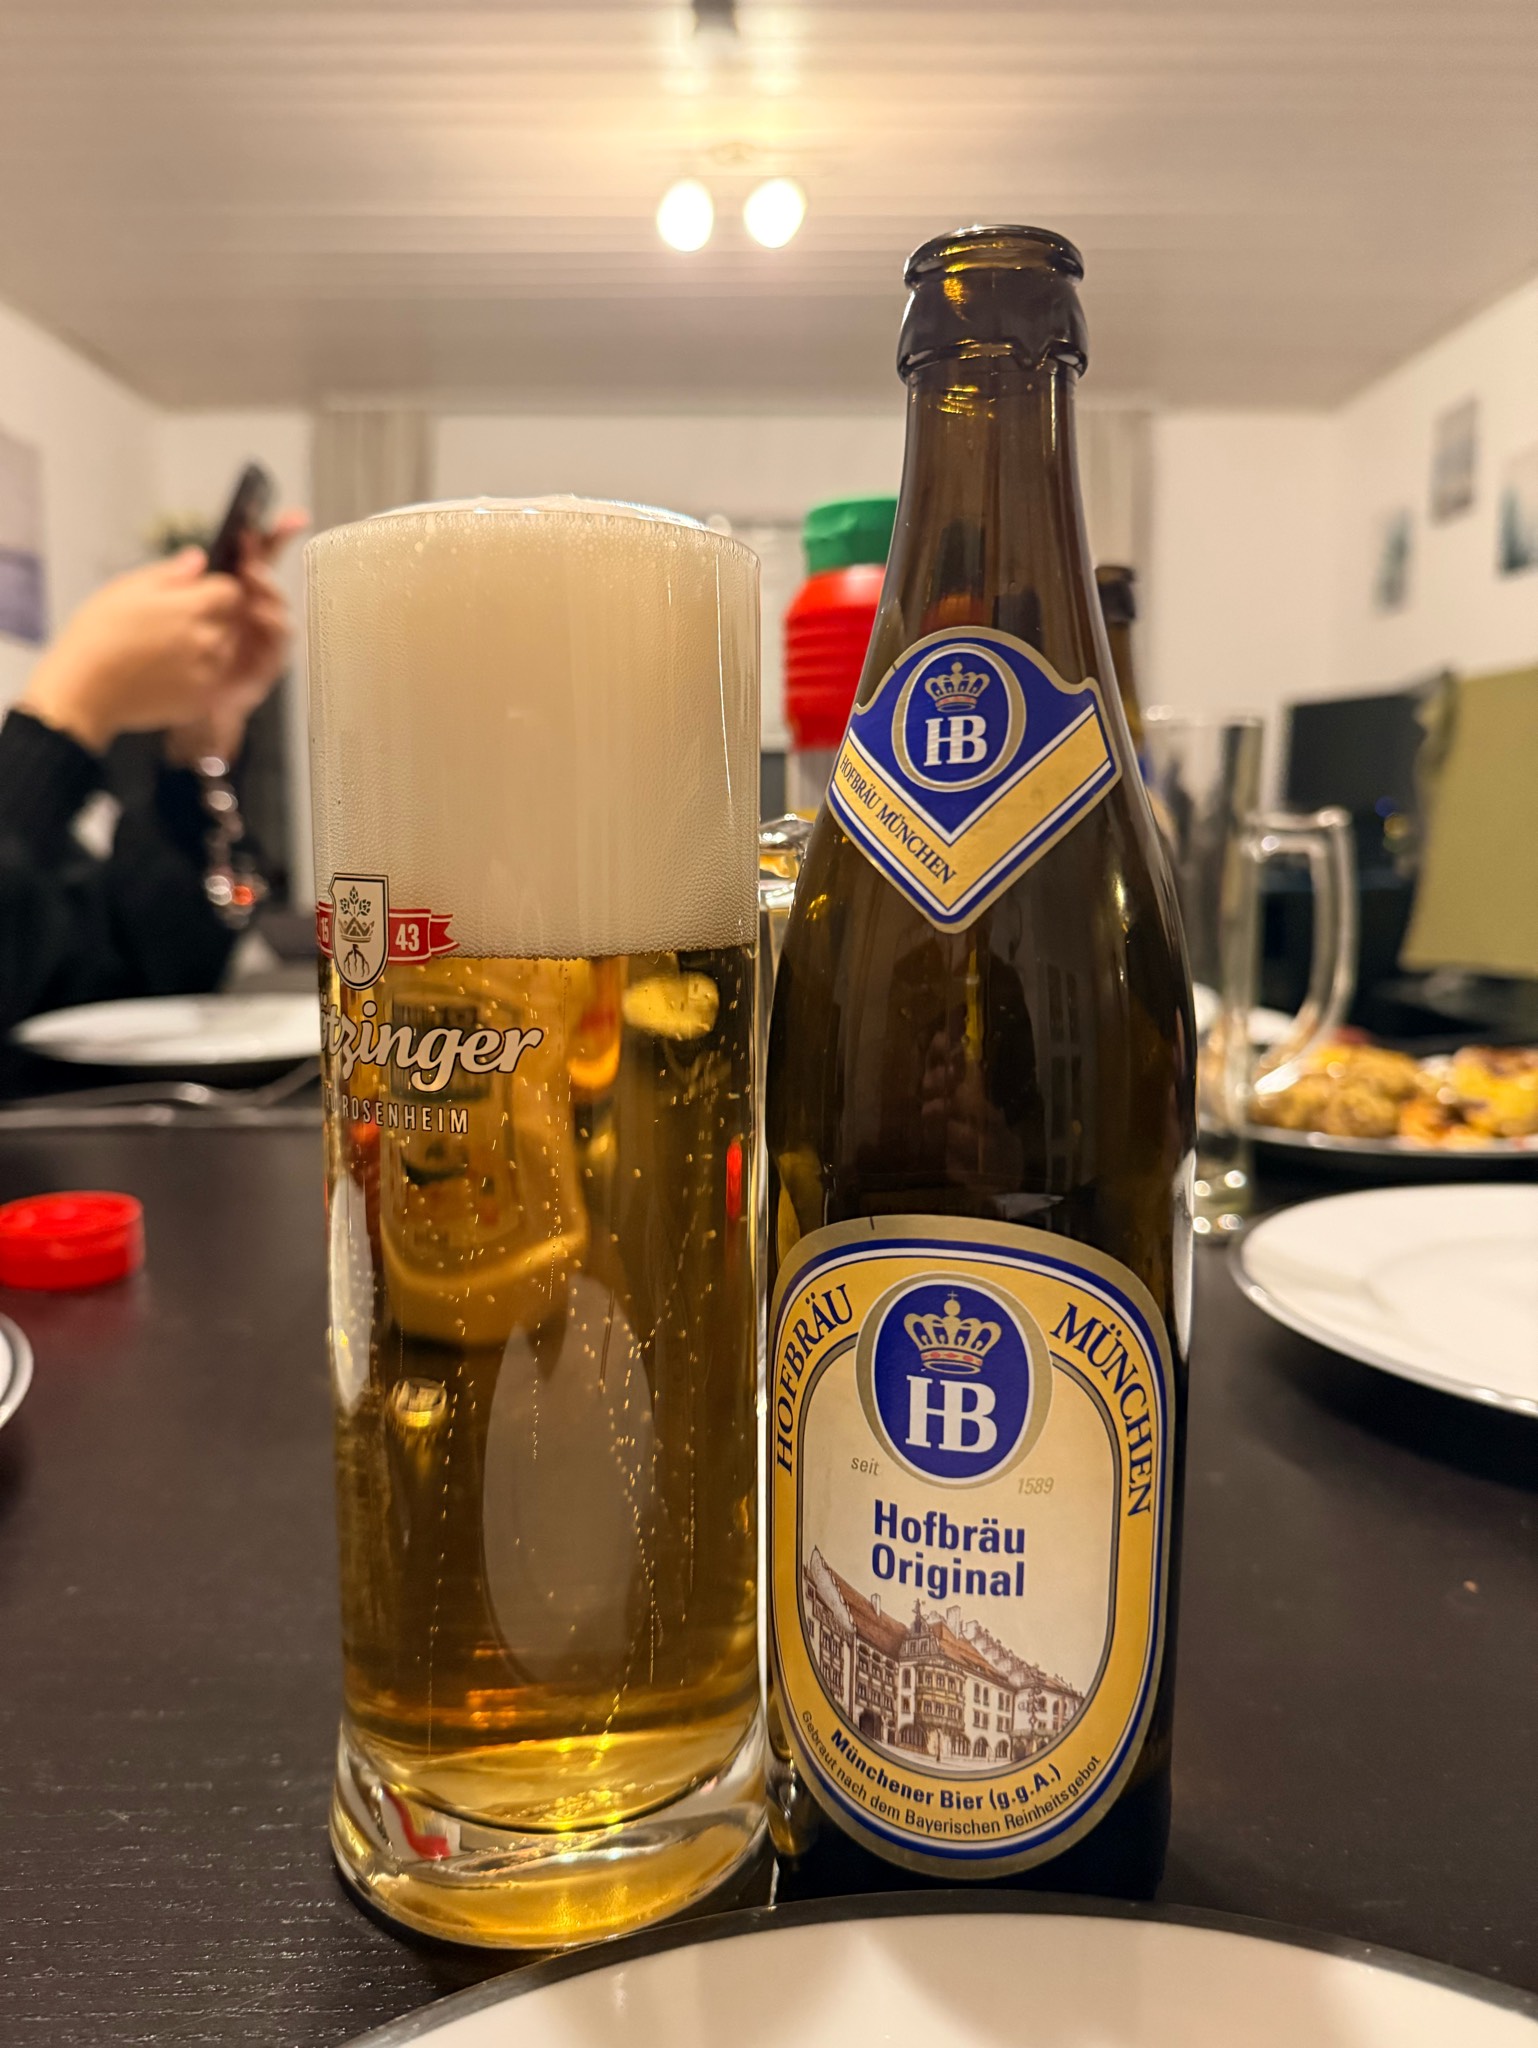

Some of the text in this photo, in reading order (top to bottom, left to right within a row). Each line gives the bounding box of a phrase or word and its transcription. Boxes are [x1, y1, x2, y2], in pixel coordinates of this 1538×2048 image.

[923, 715, 988, 766] HB
[840, 754, 957, 884] HOFBRÄU MÜNCHEN
[395, 924, 420, 951] 43
[342, 1093, 469, 1134] ROSENHEIM
[776, 1283, 1152, 1517] HOFBRÄU MÜNCHEN
[905, 1375, 998, 1454] HB
[850, 1455, 880, 1477] seit
[1016, 1477, 1055, 1494] 1589
[874, 1499, 1026, 1555] Hofbräu
[871, 1543, 1026, 1600] Original
[802, 1710, 1101, 1835] Gebraut nach dem Bayerischen Reinheitsgebot
[831, 1728, 1062, 1811] Münchener Bier (g.g.A.)
